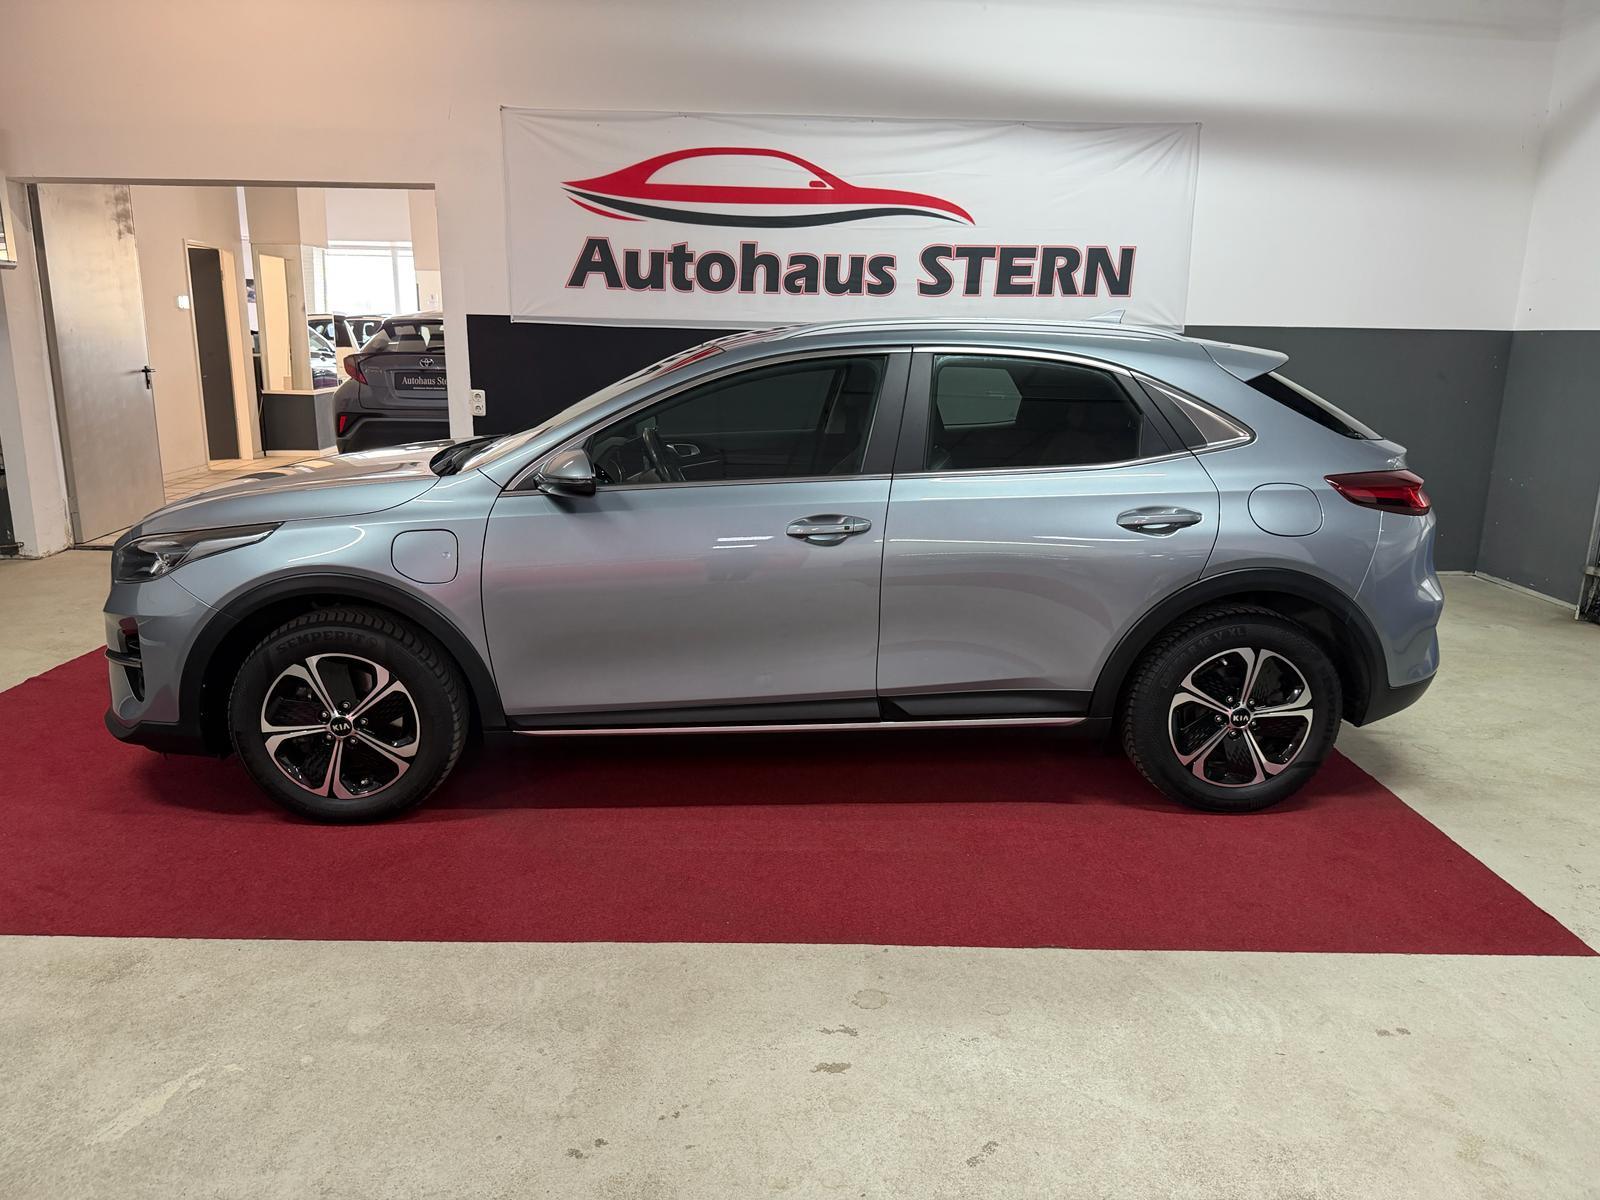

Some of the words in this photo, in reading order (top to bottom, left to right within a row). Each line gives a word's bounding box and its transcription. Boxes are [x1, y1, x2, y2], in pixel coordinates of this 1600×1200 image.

[565, 236, 897, 296] Autohaus
[917, 244, 1137, 298] STERN
[402, 376, 436, 385] Autohaus
[277, 630, 366, 652] SEMPERIT
[332, 723, 350, 731] KIA
